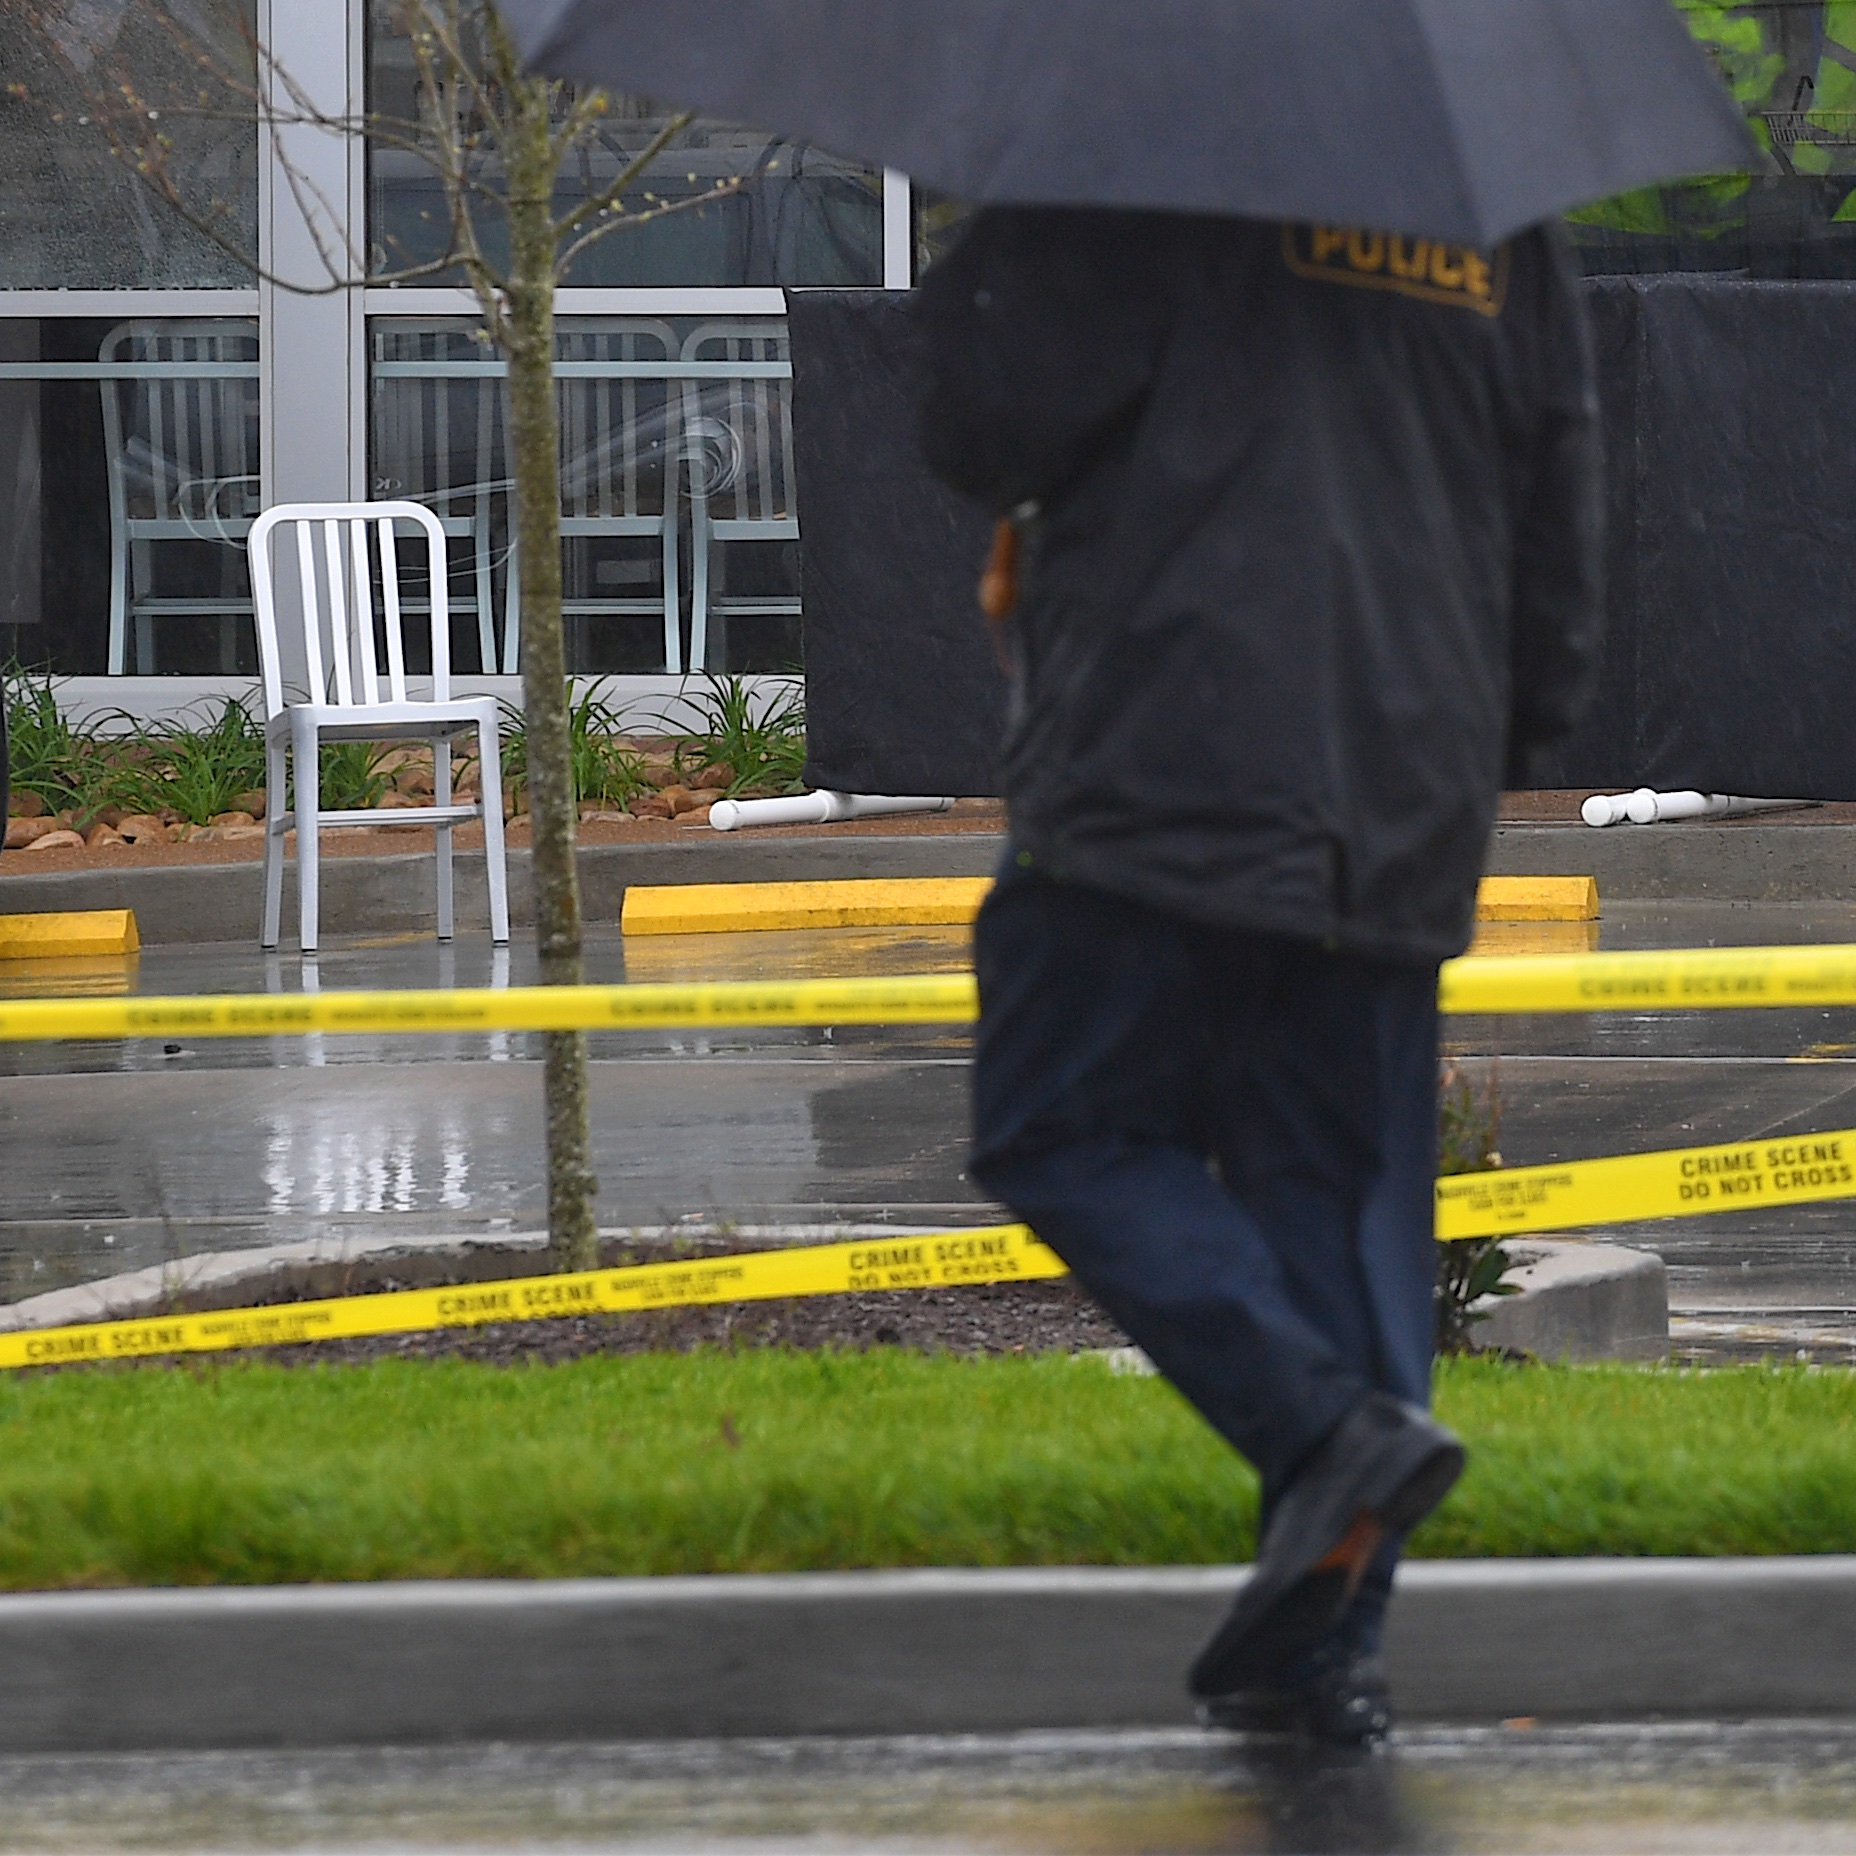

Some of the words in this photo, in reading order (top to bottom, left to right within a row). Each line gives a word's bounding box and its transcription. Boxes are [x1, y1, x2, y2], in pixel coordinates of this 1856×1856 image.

[1680, 1150, 1756, 1179] CRIME
[1766, 1140, 1842, 1169] SCENE
[1679, 1181, 1710, 1201] DO
[1720, 1174, 1763, 1195] NOT
[1774, 1164, 1852, 1190] CROSS
[850, 1245, 922, 1271] CRIME
[934, 1235, 1008, 1262] SCENE
